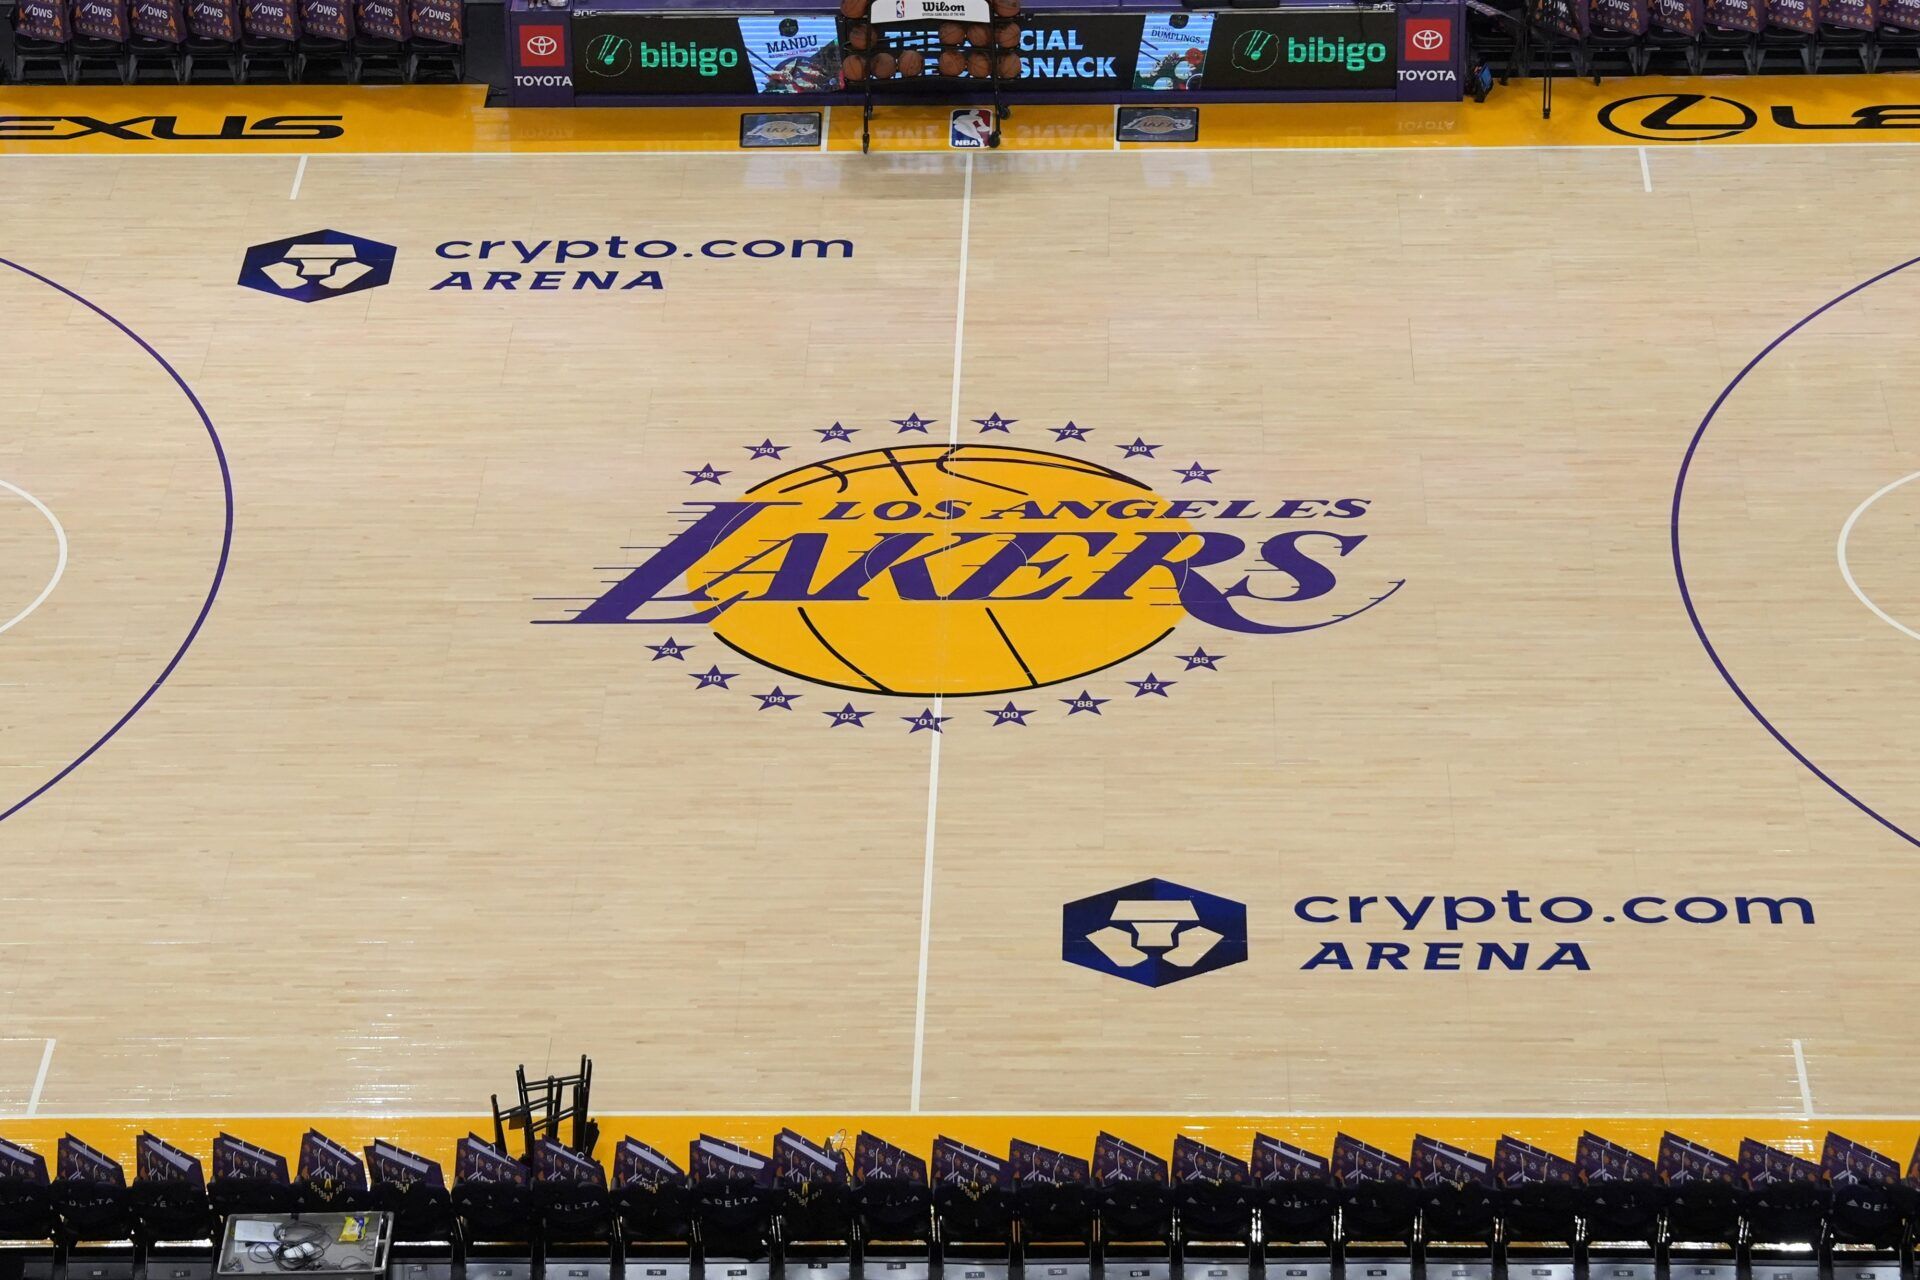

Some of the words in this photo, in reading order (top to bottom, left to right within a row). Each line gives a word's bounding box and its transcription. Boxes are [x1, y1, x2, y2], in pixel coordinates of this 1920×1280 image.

[921, 1, 966, 12] Wilson
[1151, 30, 1201, 44] DUMPLINGS
[766, 35, 818, 53] MANDU
[1287, 37, 1386, 71] bibigo
[640, 42, 738, 77] bibigo
[1019, 57, 1117, 78] SNACK
[1397, 70, 1456, 81] TOYOTA
[514, 76, 573, 87] TOYOTA
[434, 235, 854, 263] crypto.com
[428, 271, 665, 290] ARENA
[902, 420, 921, 428] '53
[984, 420, 1003, 428] '54
[825, 429, 845, 437] '52
[755, 446, 775, 454] '50
[1128, 445, 1148, 453] '80
[697, 471, 715, 479] '49
[1185, 469, 1205, 477] '82
[818, 500, 973, 521] LOS
[980, 498, 1372, 520] ANGELES
[530, 501, 1406, 635] LAKERS
[659, 646, 678, 654] '20
[1188, 656, 1209, 664] '85
[703, 674, 721, 682] '10
[1140, 682, 1160, 690] '87
[765, 695, 785, 703] '09
[1073, 700, 1094, 708] '88
[836, 712, 857, 720] '02
[998, 711, 1019, 719] '00
[915, 718, 934, 726] '01
[1293, 889, 1816, 930] crypto.com
[1299, 942, 1592, 970] ARENA
[554, 1200, 600, 1212] DELTA
[714, 1196, 759, 1208] DELTA
